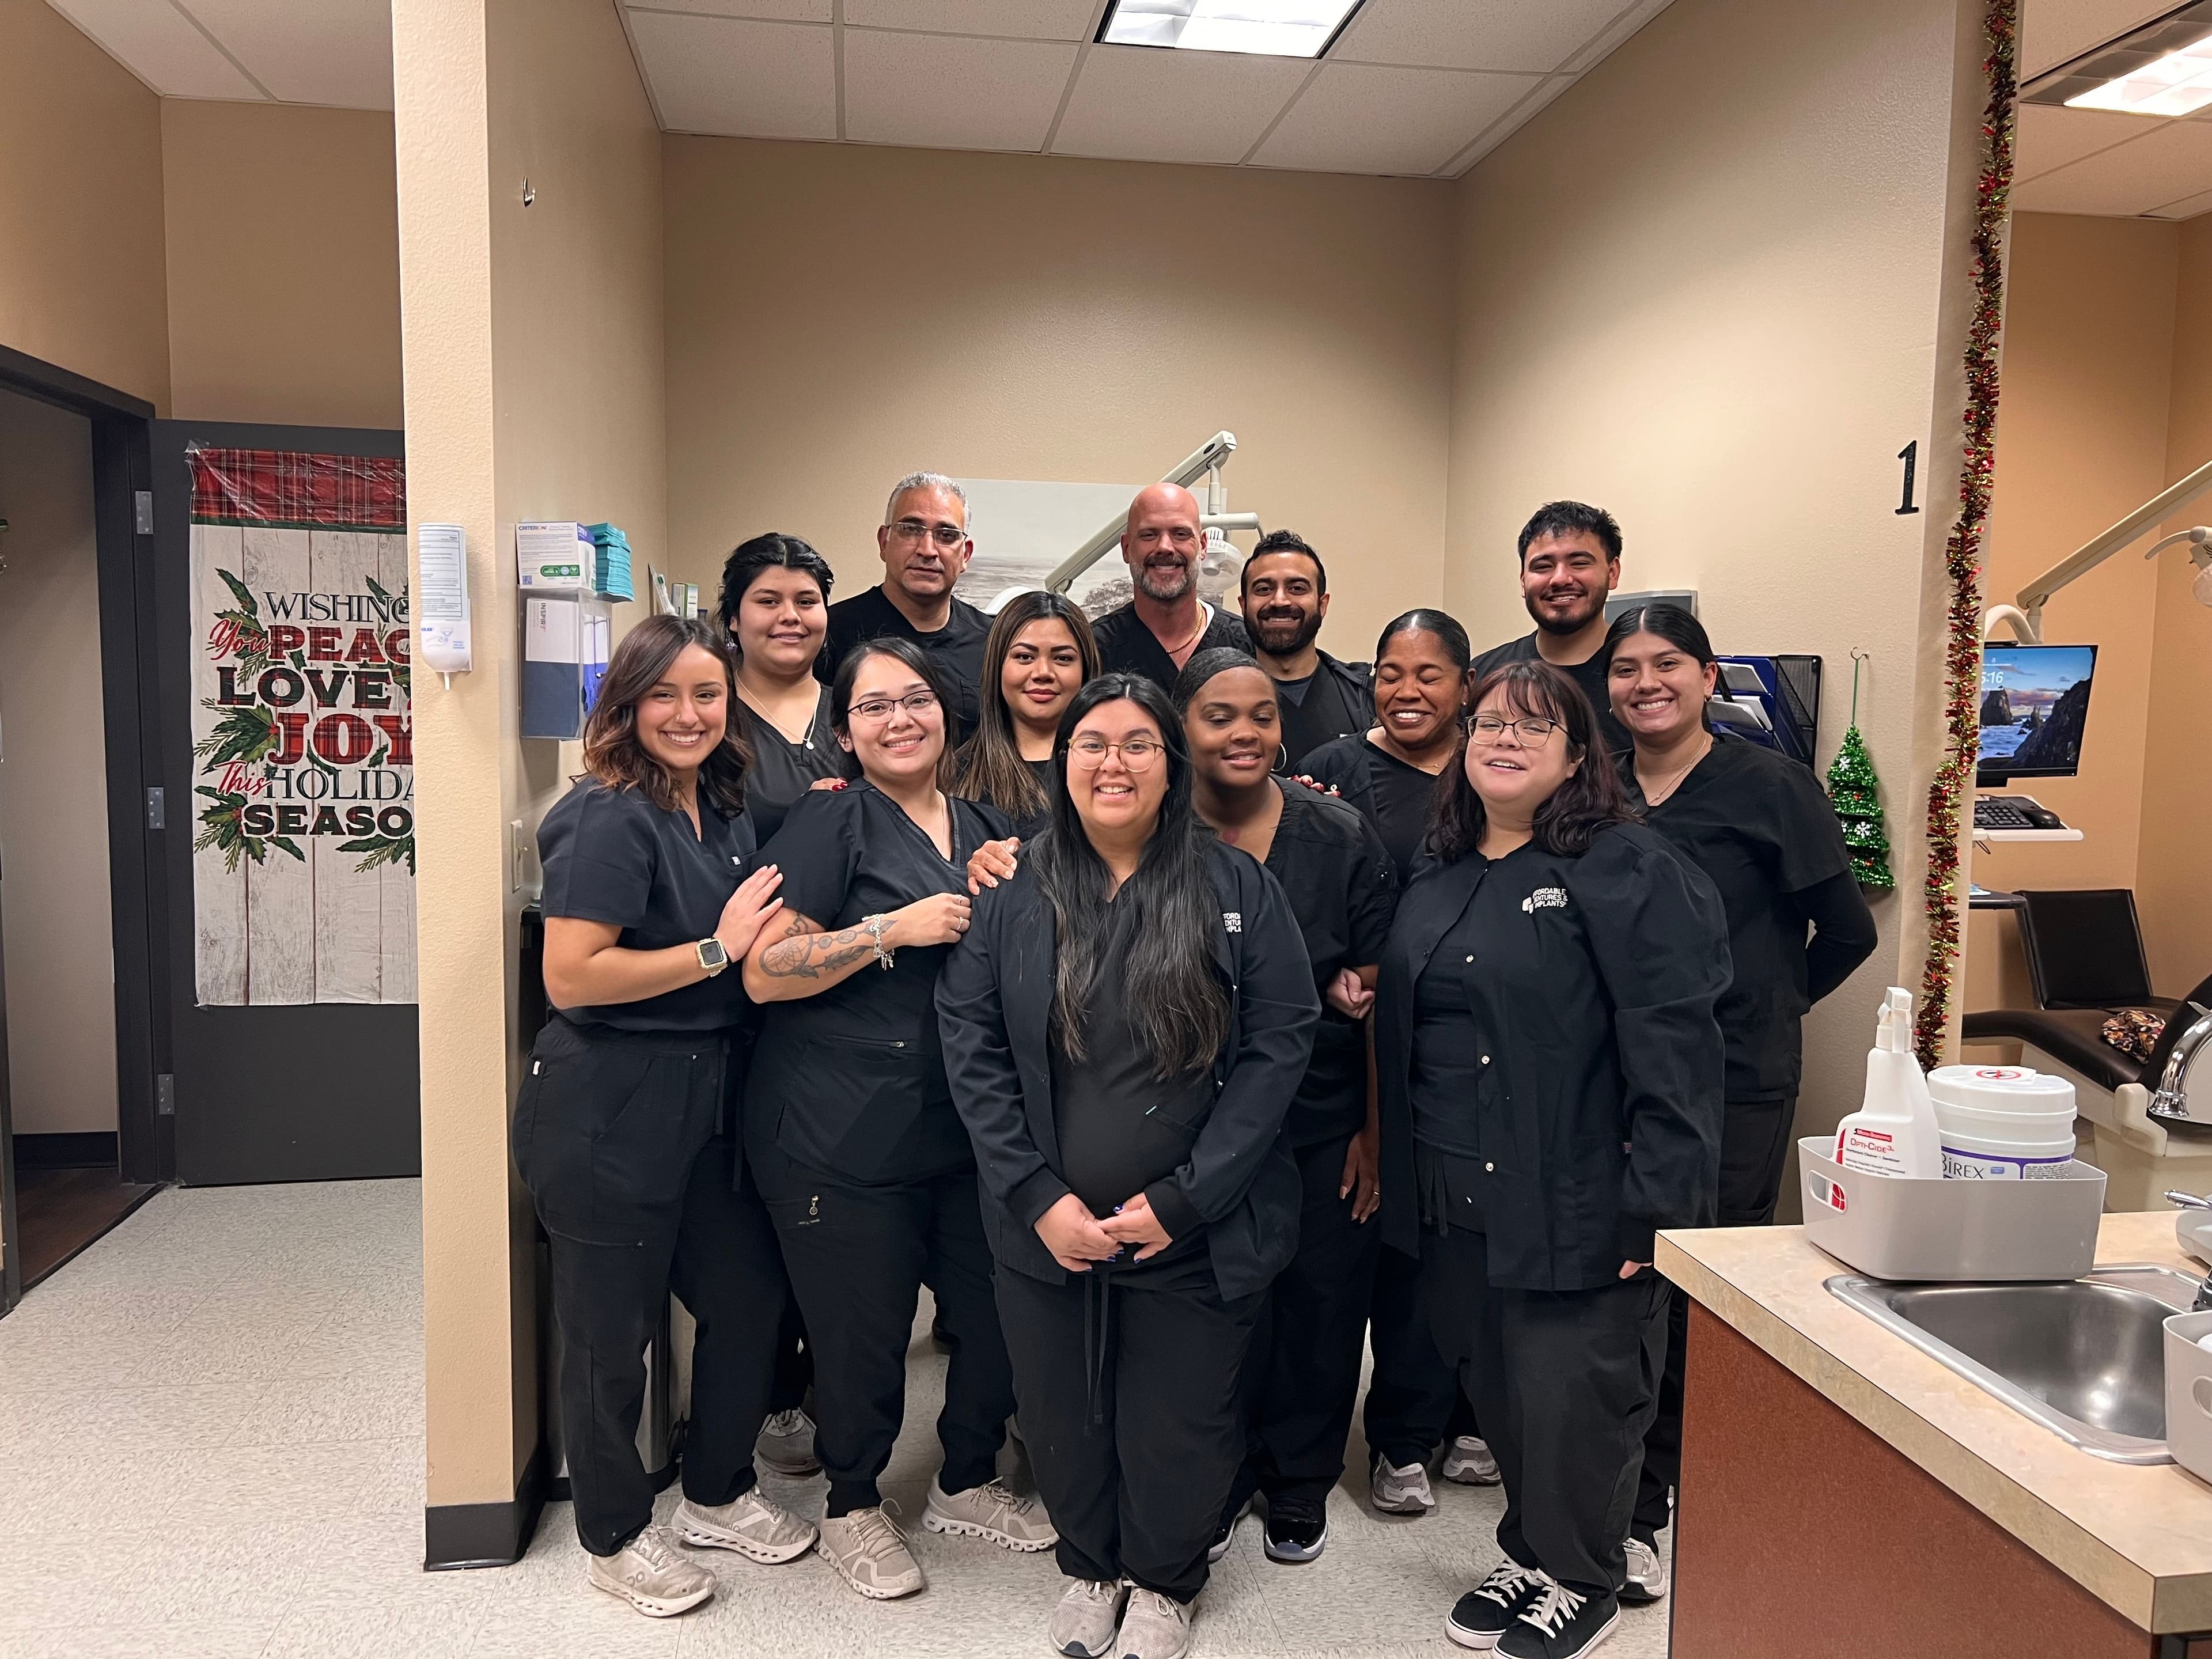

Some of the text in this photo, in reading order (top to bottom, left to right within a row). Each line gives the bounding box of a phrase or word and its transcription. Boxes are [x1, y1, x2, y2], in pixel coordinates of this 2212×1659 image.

[1895, 440, 1919, 516] 1
[263, 592, 410, 623] WISHING
[208, 618, 272, 661] You
[217, 666, 392, 710] LOVE
[268, 712, 413, 766] JOY
[213, 761, 272, 796] This
